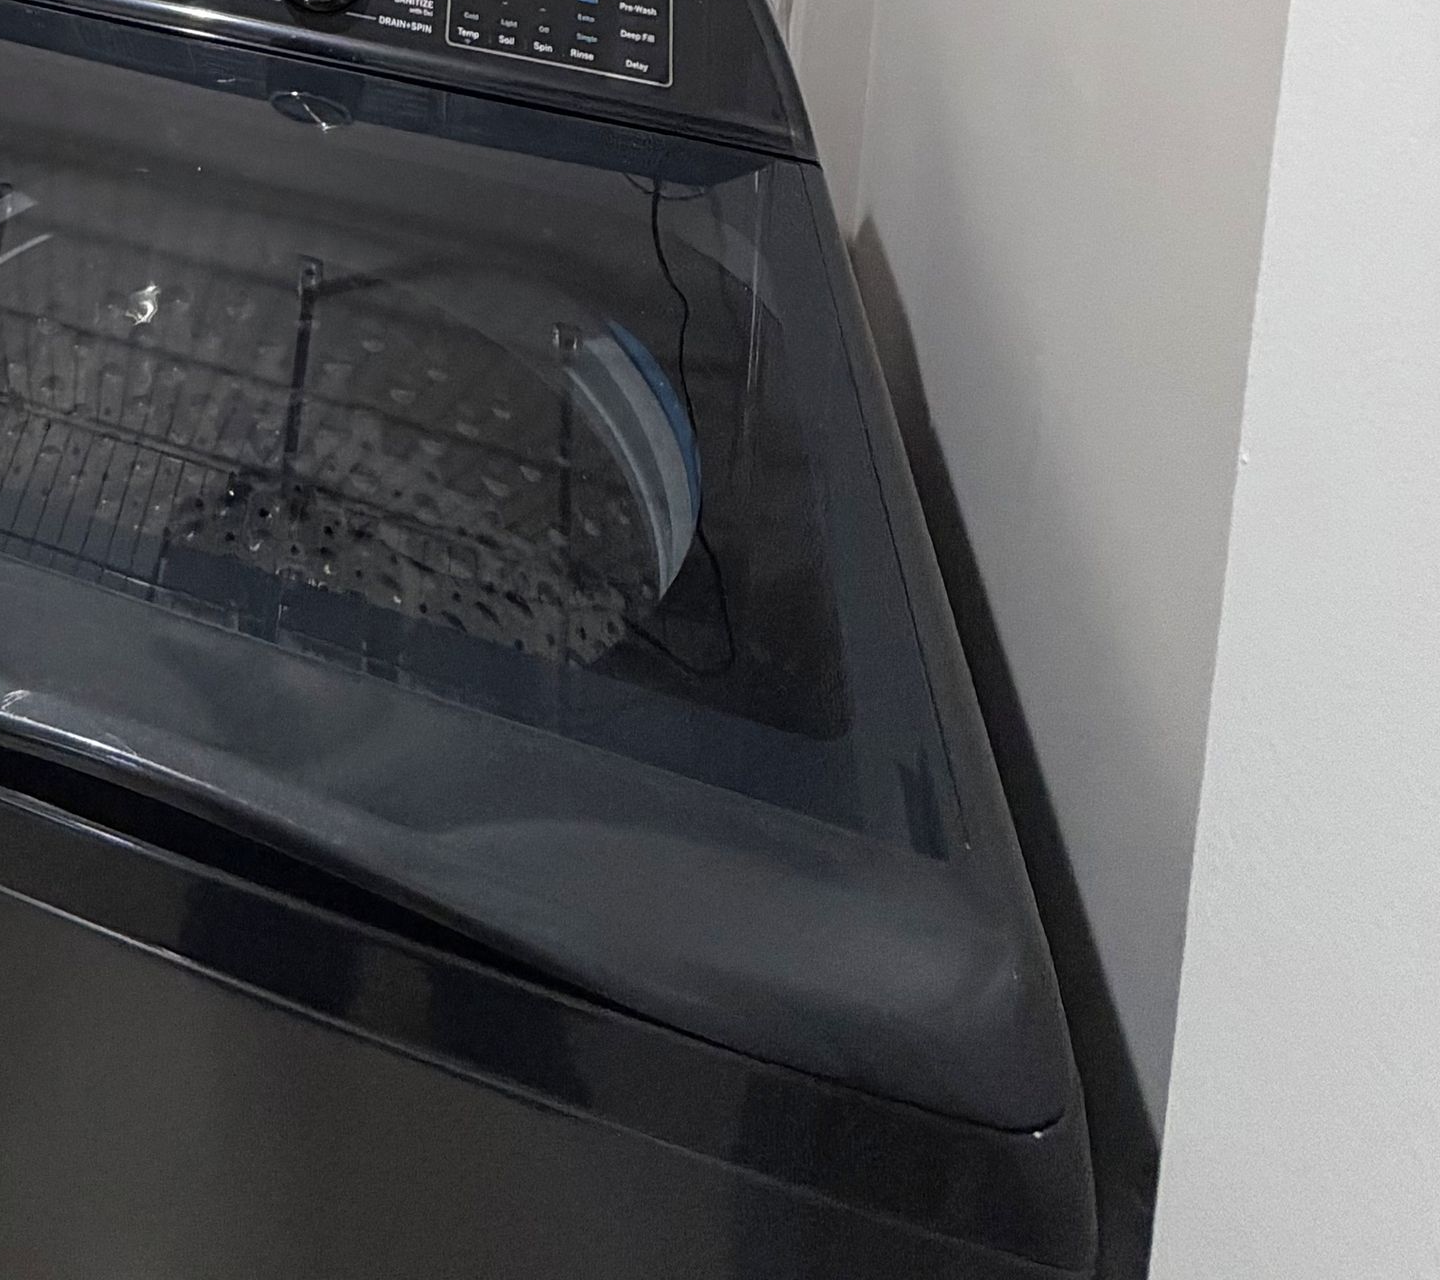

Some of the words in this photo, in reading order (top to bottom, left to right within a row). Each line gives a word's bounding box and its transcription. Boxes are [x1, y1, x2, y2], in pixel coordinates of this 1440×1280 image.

[619, 1, 658, 17] Pre-Wash
[378, 15, 433, 35] DRAIN+SPIN
[457, 26, 481, 40] Temp
[498, 34, 516, 46] Soil
[619, 29, 642, 42] Deep
[642, 33, 656, 44] Fill
[533, 41, 554, 53] Spin
[570, 48, 595, 61] Rinse
[625, 58, 649, 73] Delay
